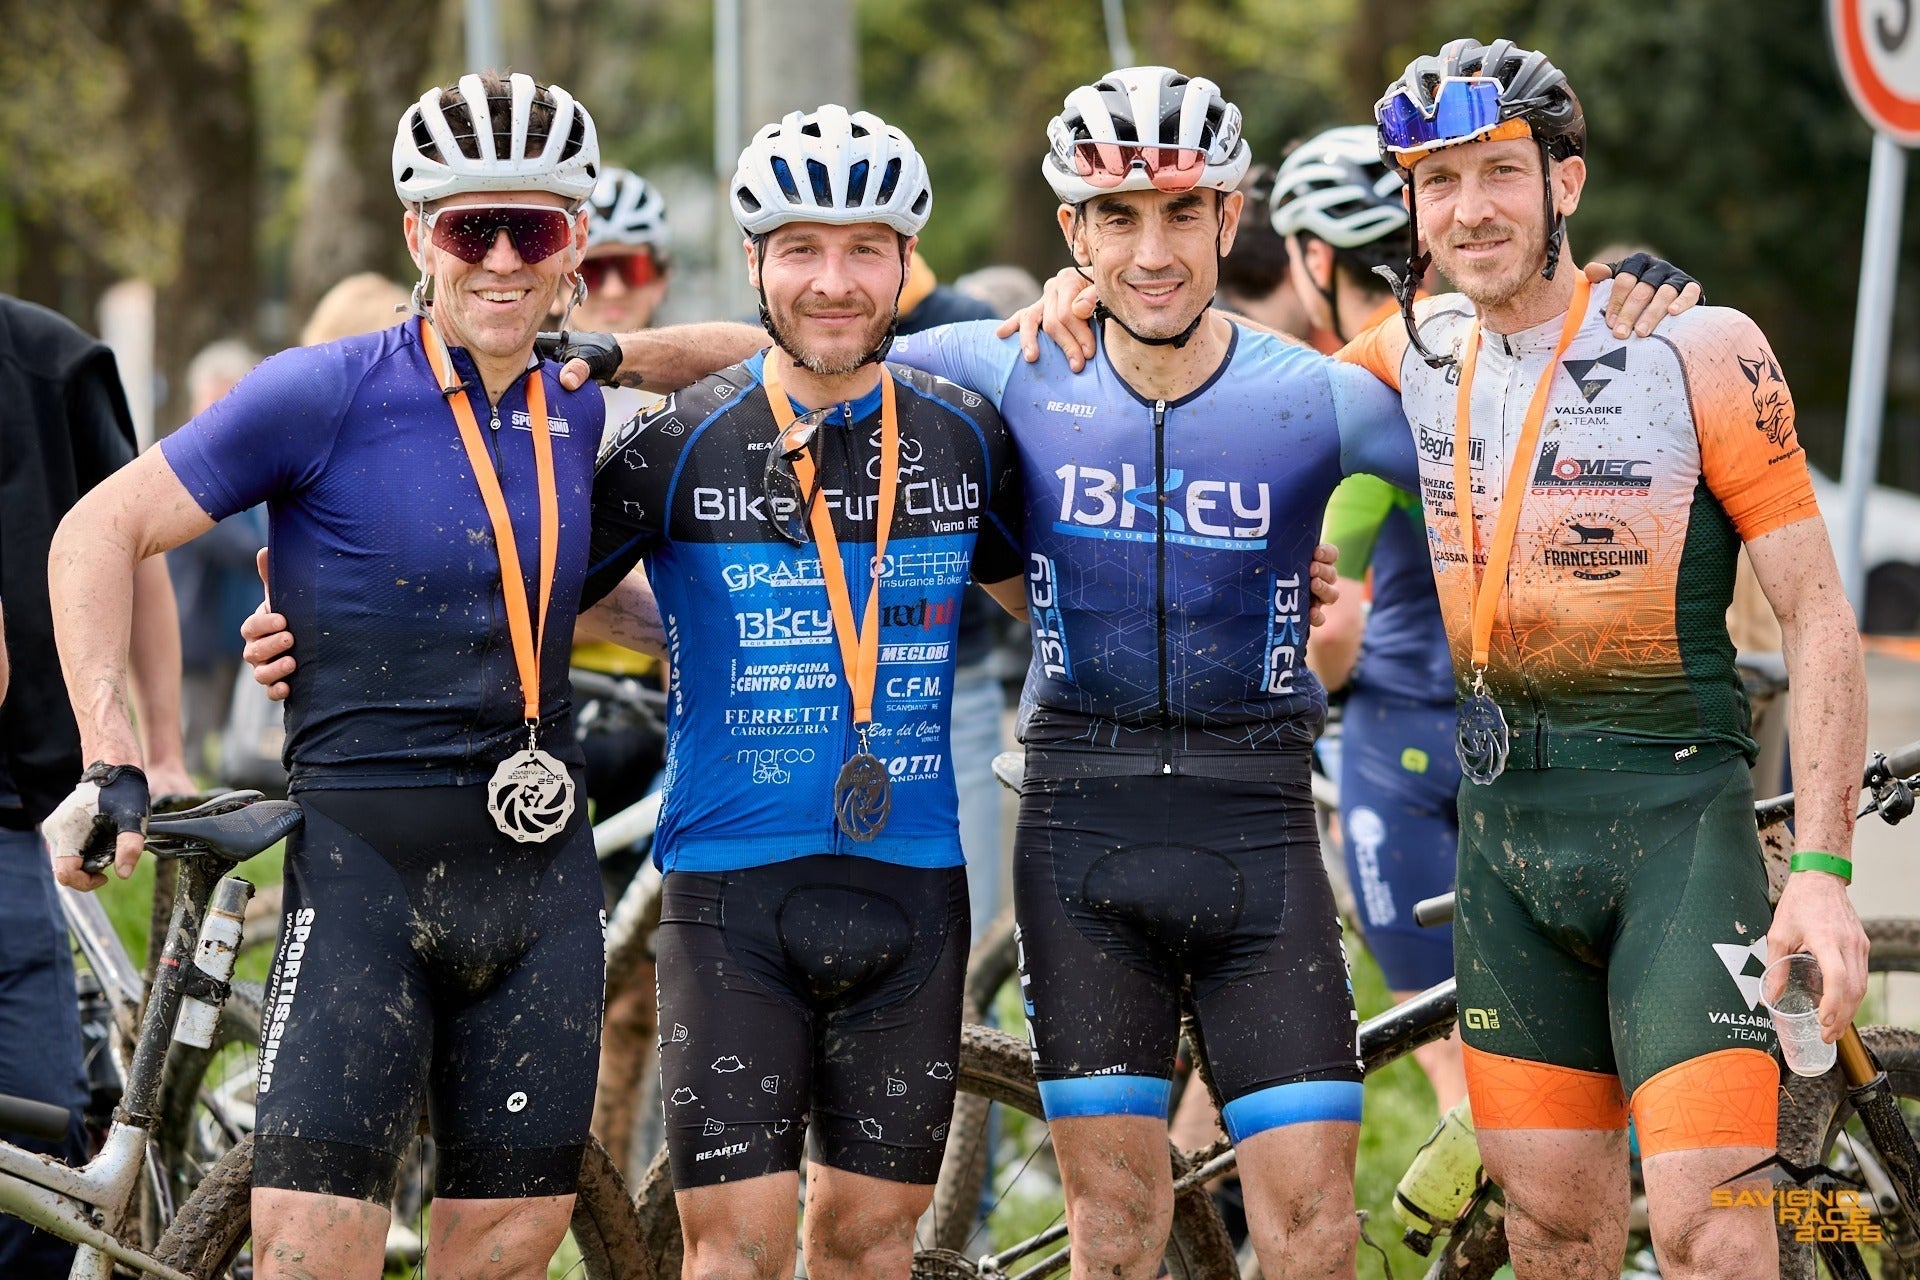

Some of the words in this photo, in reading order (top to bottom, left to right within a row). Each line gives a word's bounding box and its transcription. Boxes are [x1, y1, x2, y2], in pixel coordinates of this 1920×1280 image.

[1046, 401, 1097, 416] REARTU
[1555, 406, 1622, 415] VALSABIKE
[512, 413, 570, 434] SPOSIMO
[747, 442, 774, 451] REA
[694, 487, 800, 521] Bike
[903, 473, 979, 516] Club
[1055, 463, 1270, 538] 13KEY
[1426, 488, 1455, 500] INFISS
[1531, 488, 1650, 497] GEARINGS
[931, 519, 964, 533] Viano
[967, 516, 979, 530] RE
[1103, 530, 1143, 541] YOUR
[1225, 541, 1252, 550] DNA
[1544, 549, 1649, 567] FRANCESCHINI
[721, 558, 843, 592] GRAFF
[879, 577, 935, 588] Insurance
[735, 607, 832, 639] 13KEY
[1029, 552, 1066, 679] 13KEY
[1267, 572, 1302, 694] 13KEY
[744, 662, 830, 675] AUTOFFICINA
[736, 676, 791, 692] CENTRO
[794, 674, 838, 690] AUTO
[886, 676, 942, 698] C.F.M.
[725, 705, 839, 724] FERRETTI
[731, 724, 829, 736] CARROZZERIA
[868, 723, 893, 738] Bar
[896, 723, 915, 736] del
[737, 748, 815, 764] marco
[879, 754, 942, 776] OTTI
[890, 773, 939, 782] ANDIANO
[259, 907, 316, 1094] SPORTISSIMO
[696, 1141, 750, 1162] REARTU
